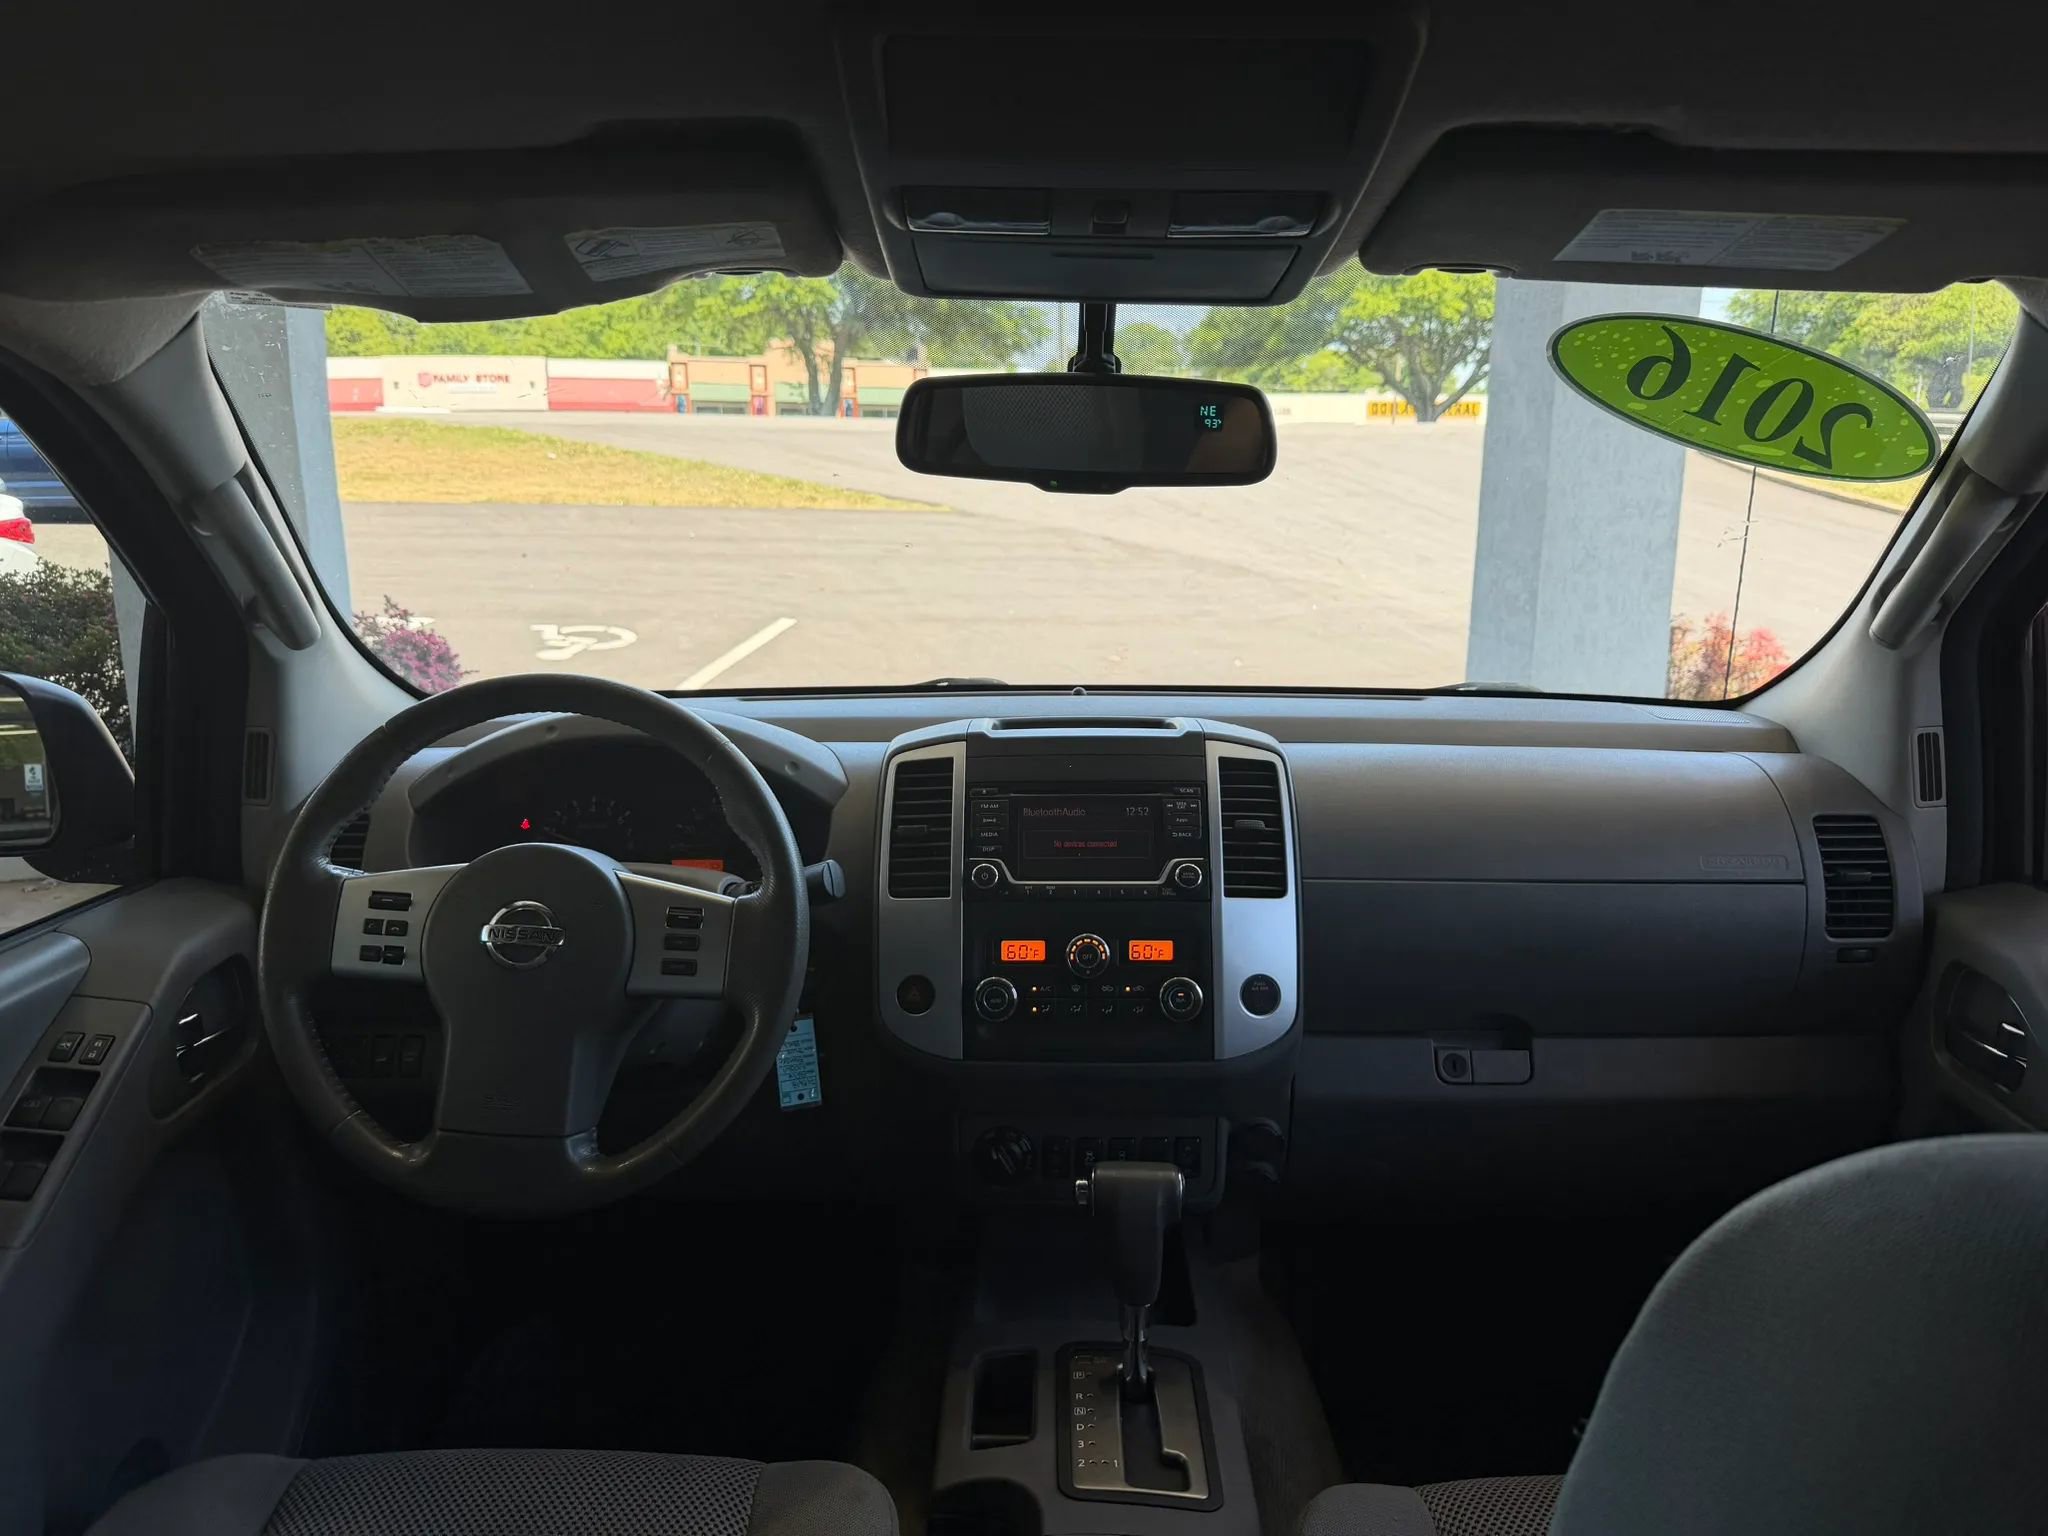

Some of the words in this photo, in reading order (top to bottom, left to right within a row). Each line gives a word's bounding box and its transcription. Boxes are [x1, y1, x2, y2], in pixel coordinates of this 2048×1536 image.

[433, 374, 470, 383] FAMILY
[475, 374, 510, 384] STORE
[1200, 405, 1216, 416] NE
[1126, 806, 1149, 816] 12:52
[489, 927, 556, 942] NISSAN
[1076, 1423, 1085, 1431] D
[1077, 1440, 1085, 1448] 3
[1078, 1459, 1086, 1467] 2
